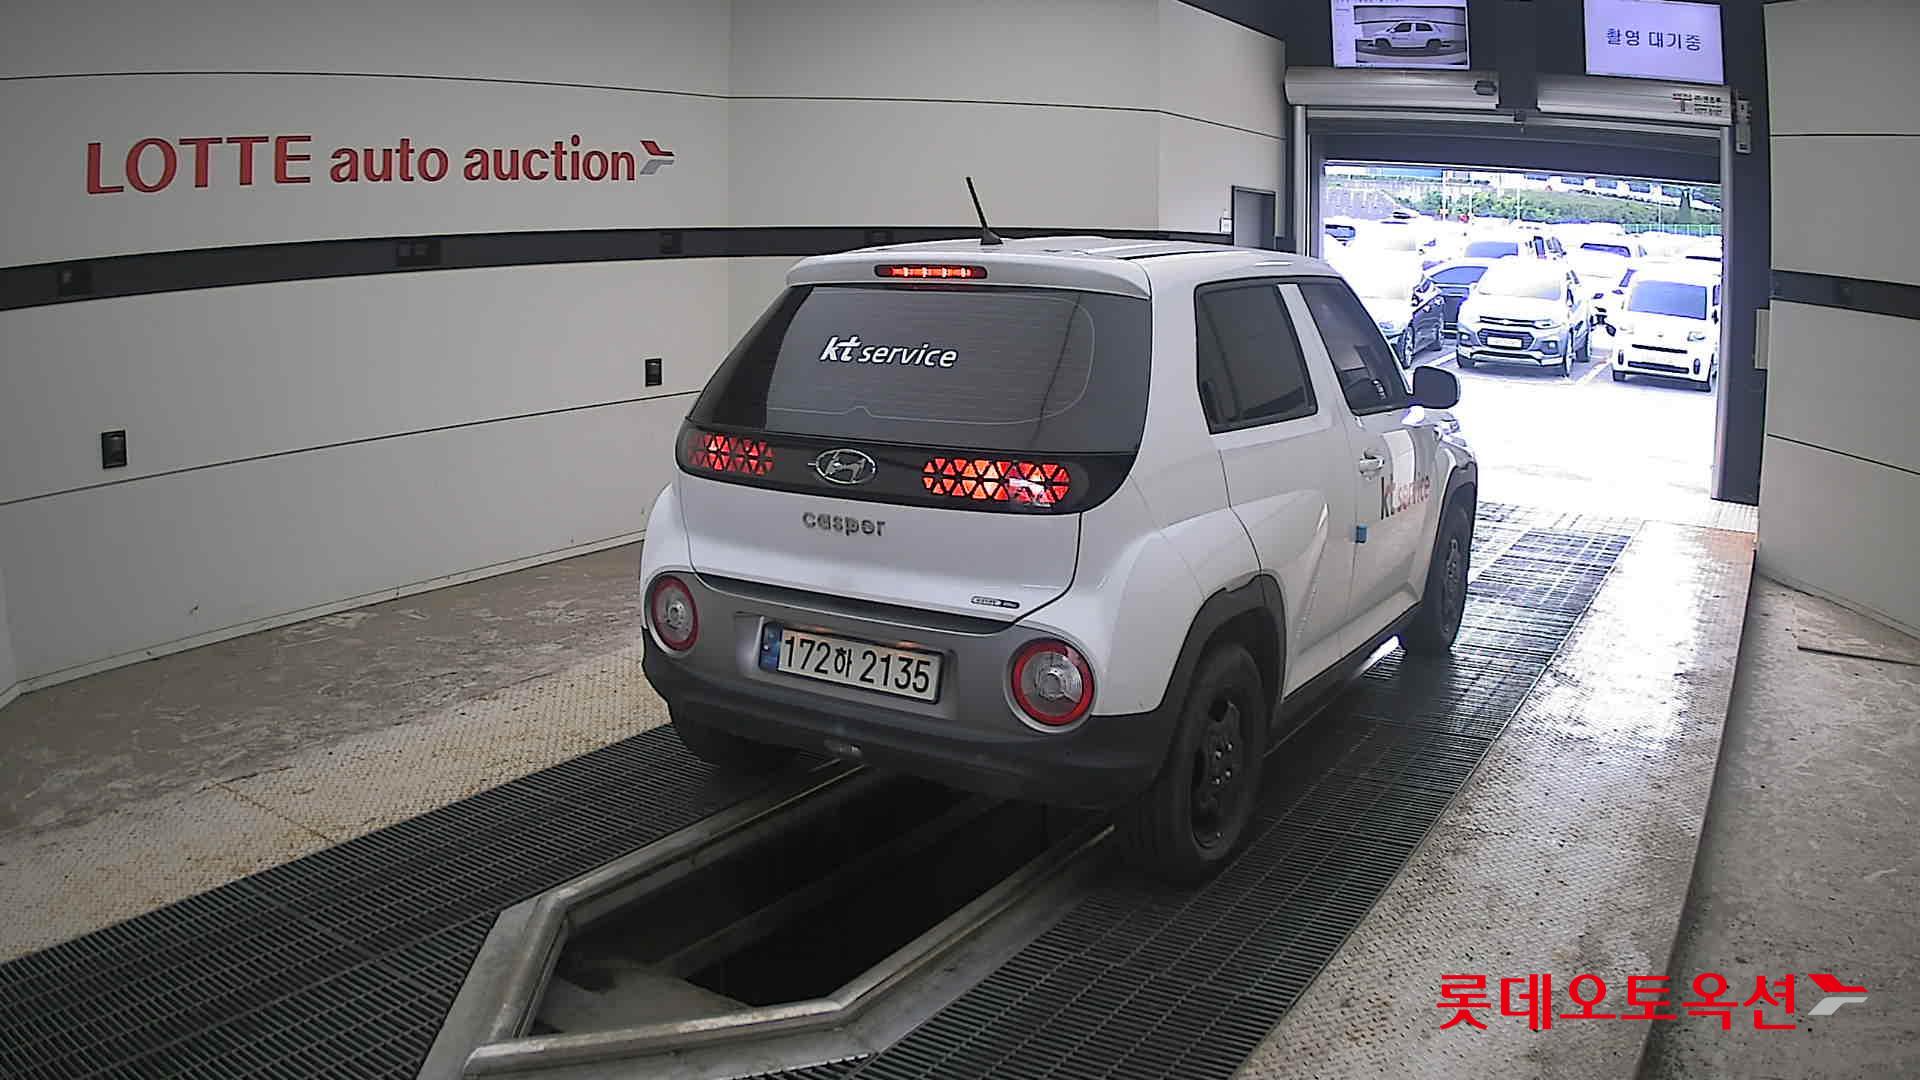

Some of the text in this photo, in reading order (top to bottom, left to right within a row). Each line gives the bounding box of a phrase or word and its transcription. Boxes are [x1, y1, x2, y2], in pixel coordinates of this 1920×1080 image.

[1648, 32, 1702, 52] 대기중
[86, 134, 637, 195] LOTTE auto auction
[820, 335, 957, 368] kt service
[802, 511, 886, 537] casper
[784, 635, 931, 694] 172하 2135
